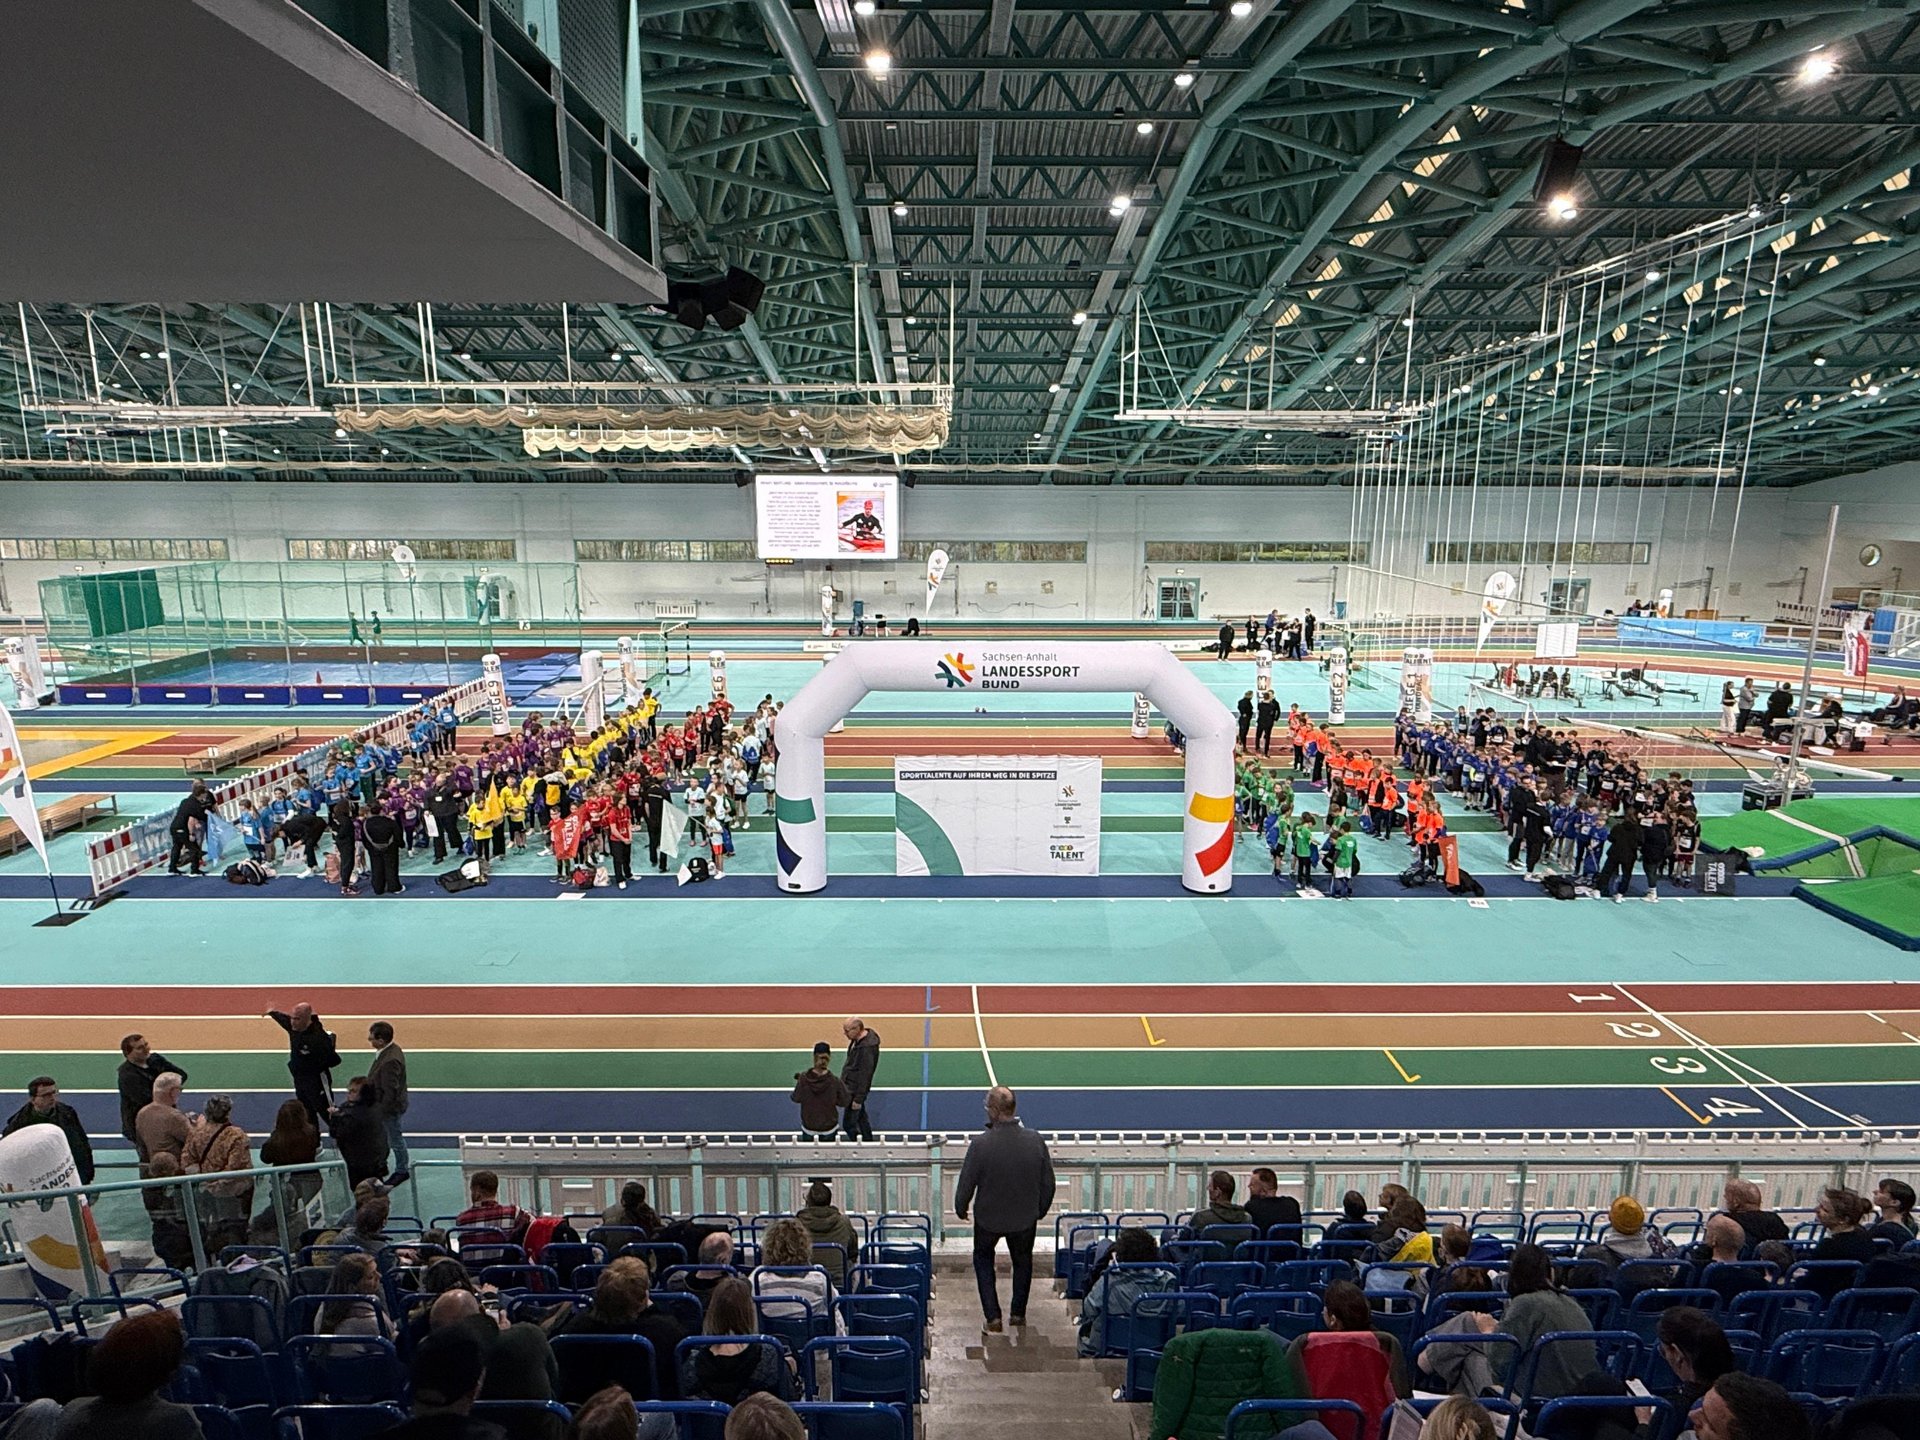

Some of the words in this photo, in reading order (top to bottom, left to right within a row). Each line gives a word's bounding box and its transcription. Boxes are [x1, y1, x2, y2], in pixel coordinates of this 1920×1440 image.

[982, 652, 1057, 662] Sachsen-Anhalt
[982, 666, 1080, 678] LANDESSPORT
[487, 680, 500, 688] 9
[982, 680, 1020, 689] BUND
[1331, 682, 1343, 714] RIEGE
[1404, 681, 1416, 714] RIEGE
[487, 690, 504, 725] RIEGE
[1050, 851, 1085, 859] TALENT
[1707, 862, 1718, 892] TALENT
[1568, 993, 1616, 1003] 1
[1605, 1022, 1661, 1038] 2
[1650, 1057, 1707, 1074] 3
[1703, 1097, 1764, 1117] 4
